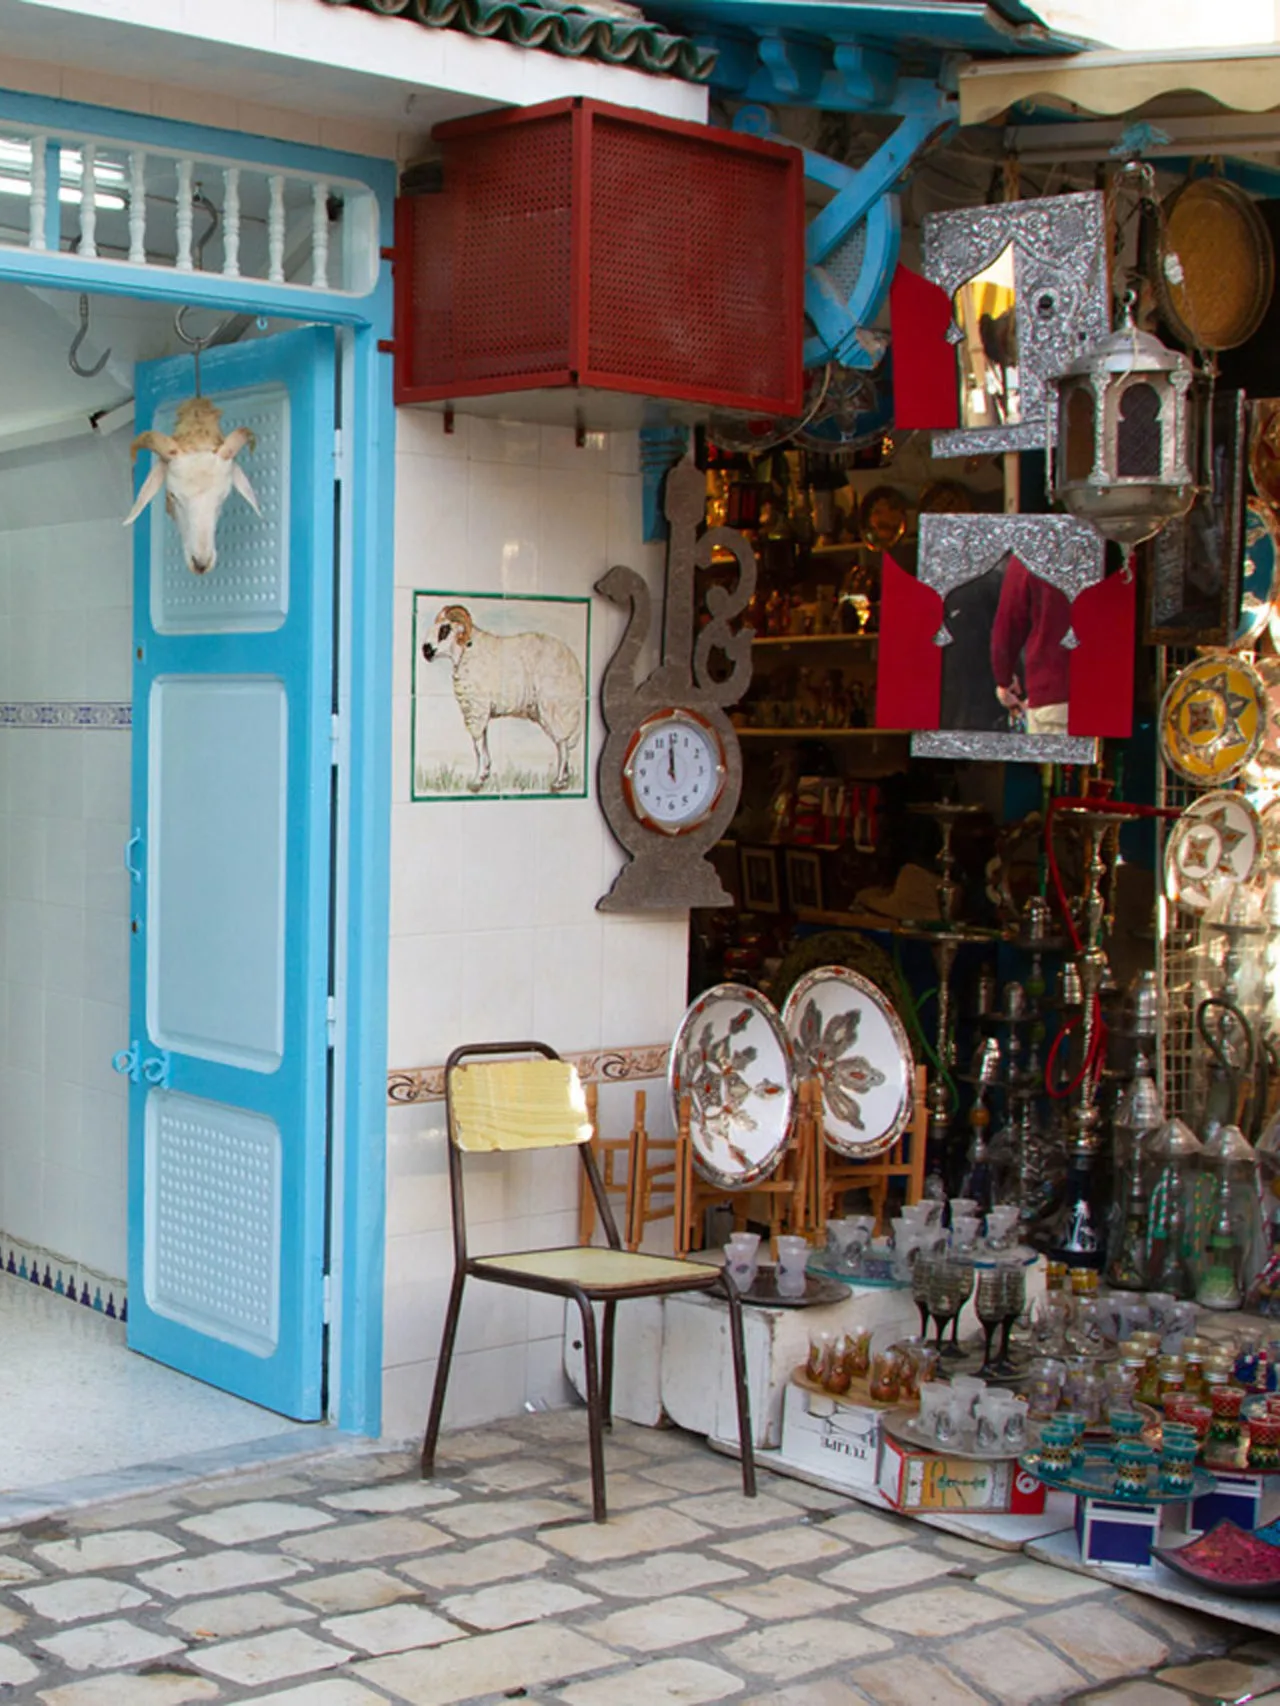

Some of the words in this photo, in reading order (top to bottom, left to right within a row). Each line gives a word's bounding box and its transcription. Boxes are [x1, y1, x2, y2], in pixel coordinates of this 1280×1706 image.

[655, 738, 665, 749] 11
[644, 749, 655, 760] 10
[693, 748, 700, 759] 2
[639, 767, 647, 778] 9
[698, 765, 704, 777] 3
[643, 785, 650, 796] 8
[692, 783, 699, 794] 4
[667, 800, 676, 811] 6
[681, 795, 689, 807] 5
